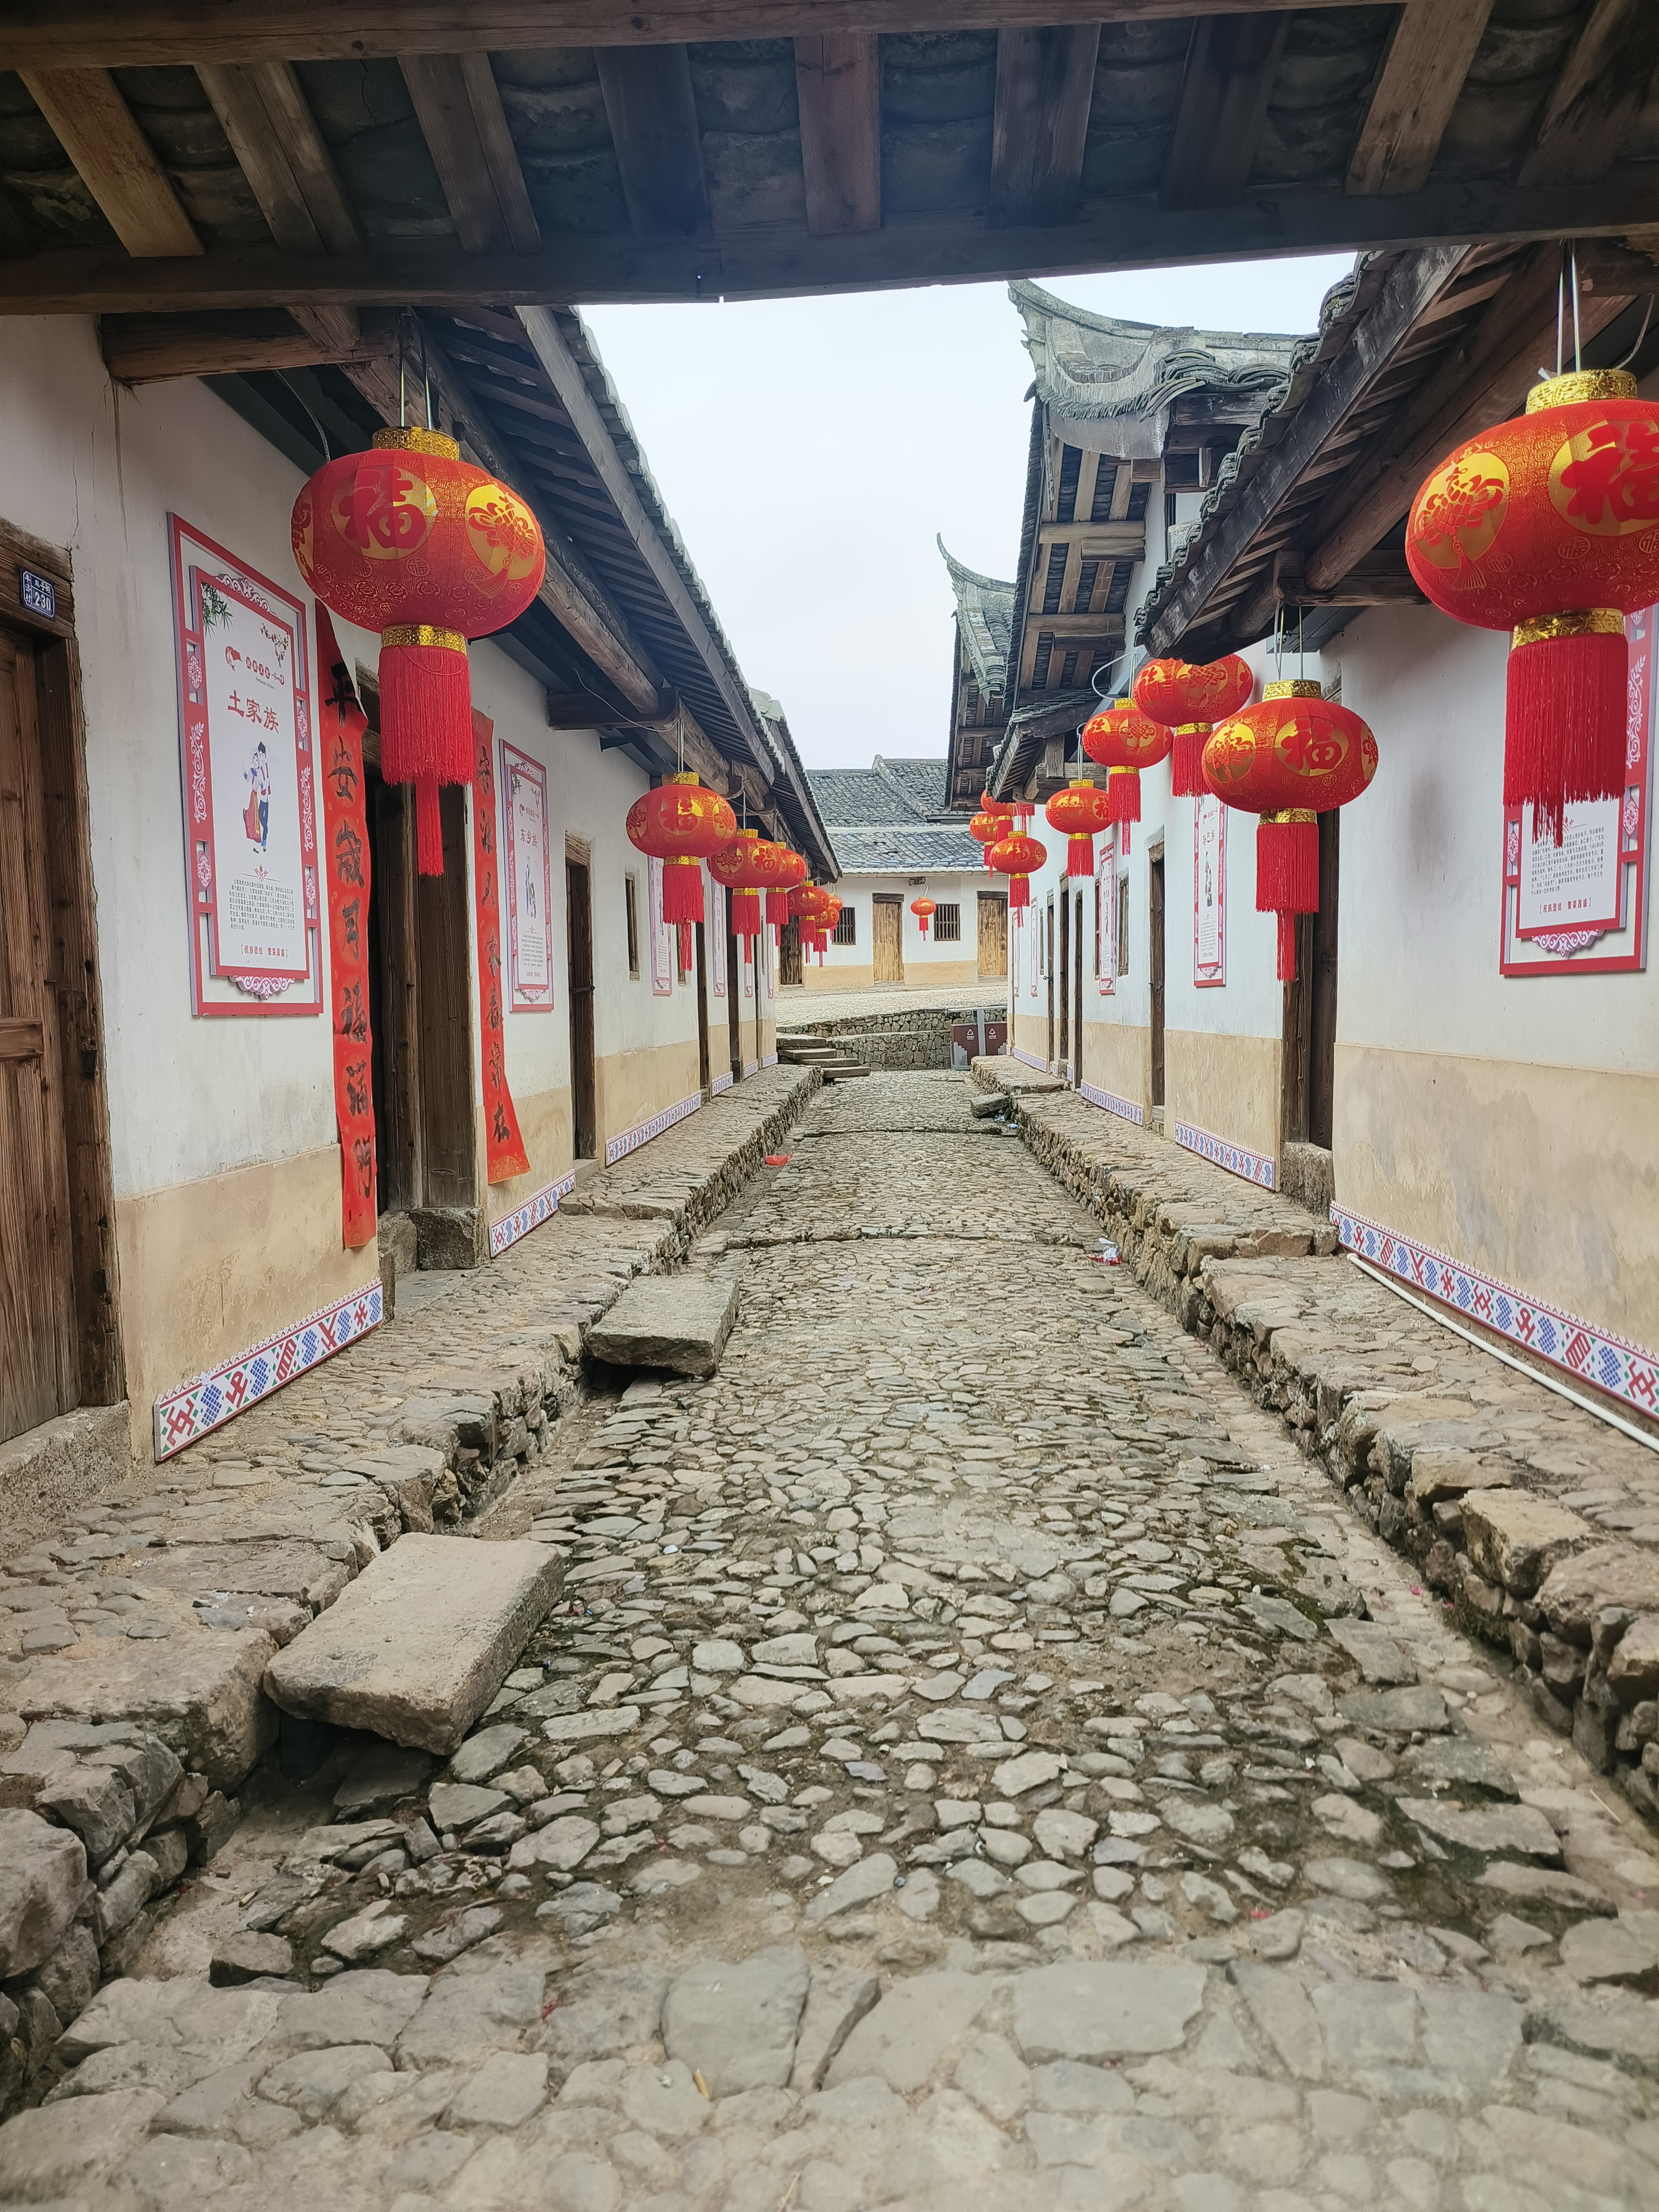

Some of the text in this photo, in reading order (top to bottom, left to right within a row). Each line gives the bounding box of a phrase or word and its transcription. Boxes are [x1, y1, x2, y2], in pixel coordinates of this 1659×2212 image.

[338, 466, 427, 549] 福
[35, 591, 51, 611] 230
[227, 689, 279, 734] 土家族
[1281, 717, 1343, 770] 福
[660, 798, 698, 831] 福
[520, 827, 538, 848] 东乡族
[753, 847, 776, 871] 福
